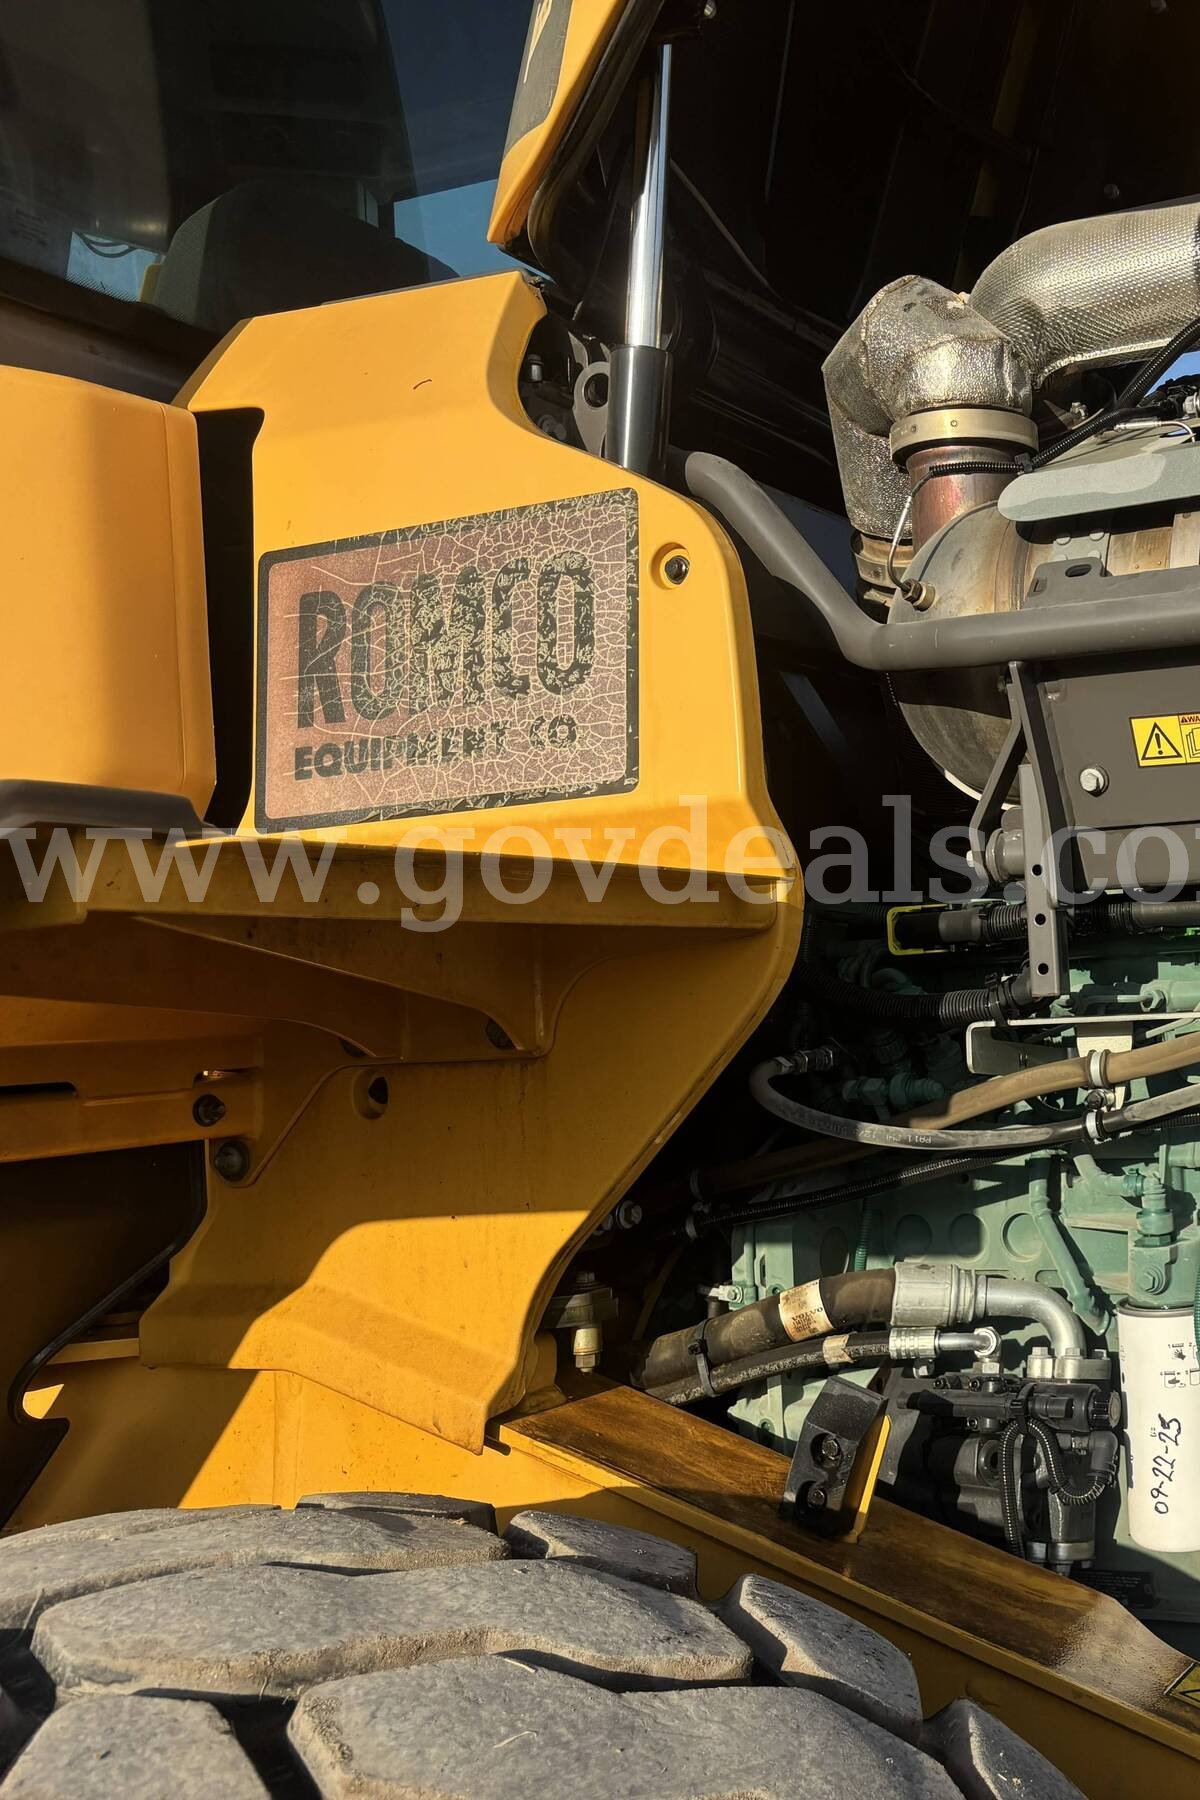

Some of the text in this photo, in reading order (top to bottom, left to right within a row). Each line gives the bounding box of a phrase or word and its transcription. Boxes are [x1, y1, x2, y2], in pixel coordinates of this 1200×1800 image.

[297, 550, 596, 729] ROMCO
[294, 719, 509, 782] EQUIPMENT
[791, 1306, 824, 1322] VOLVO
[1150, 1412, 1182, 1515] 09-22-25
